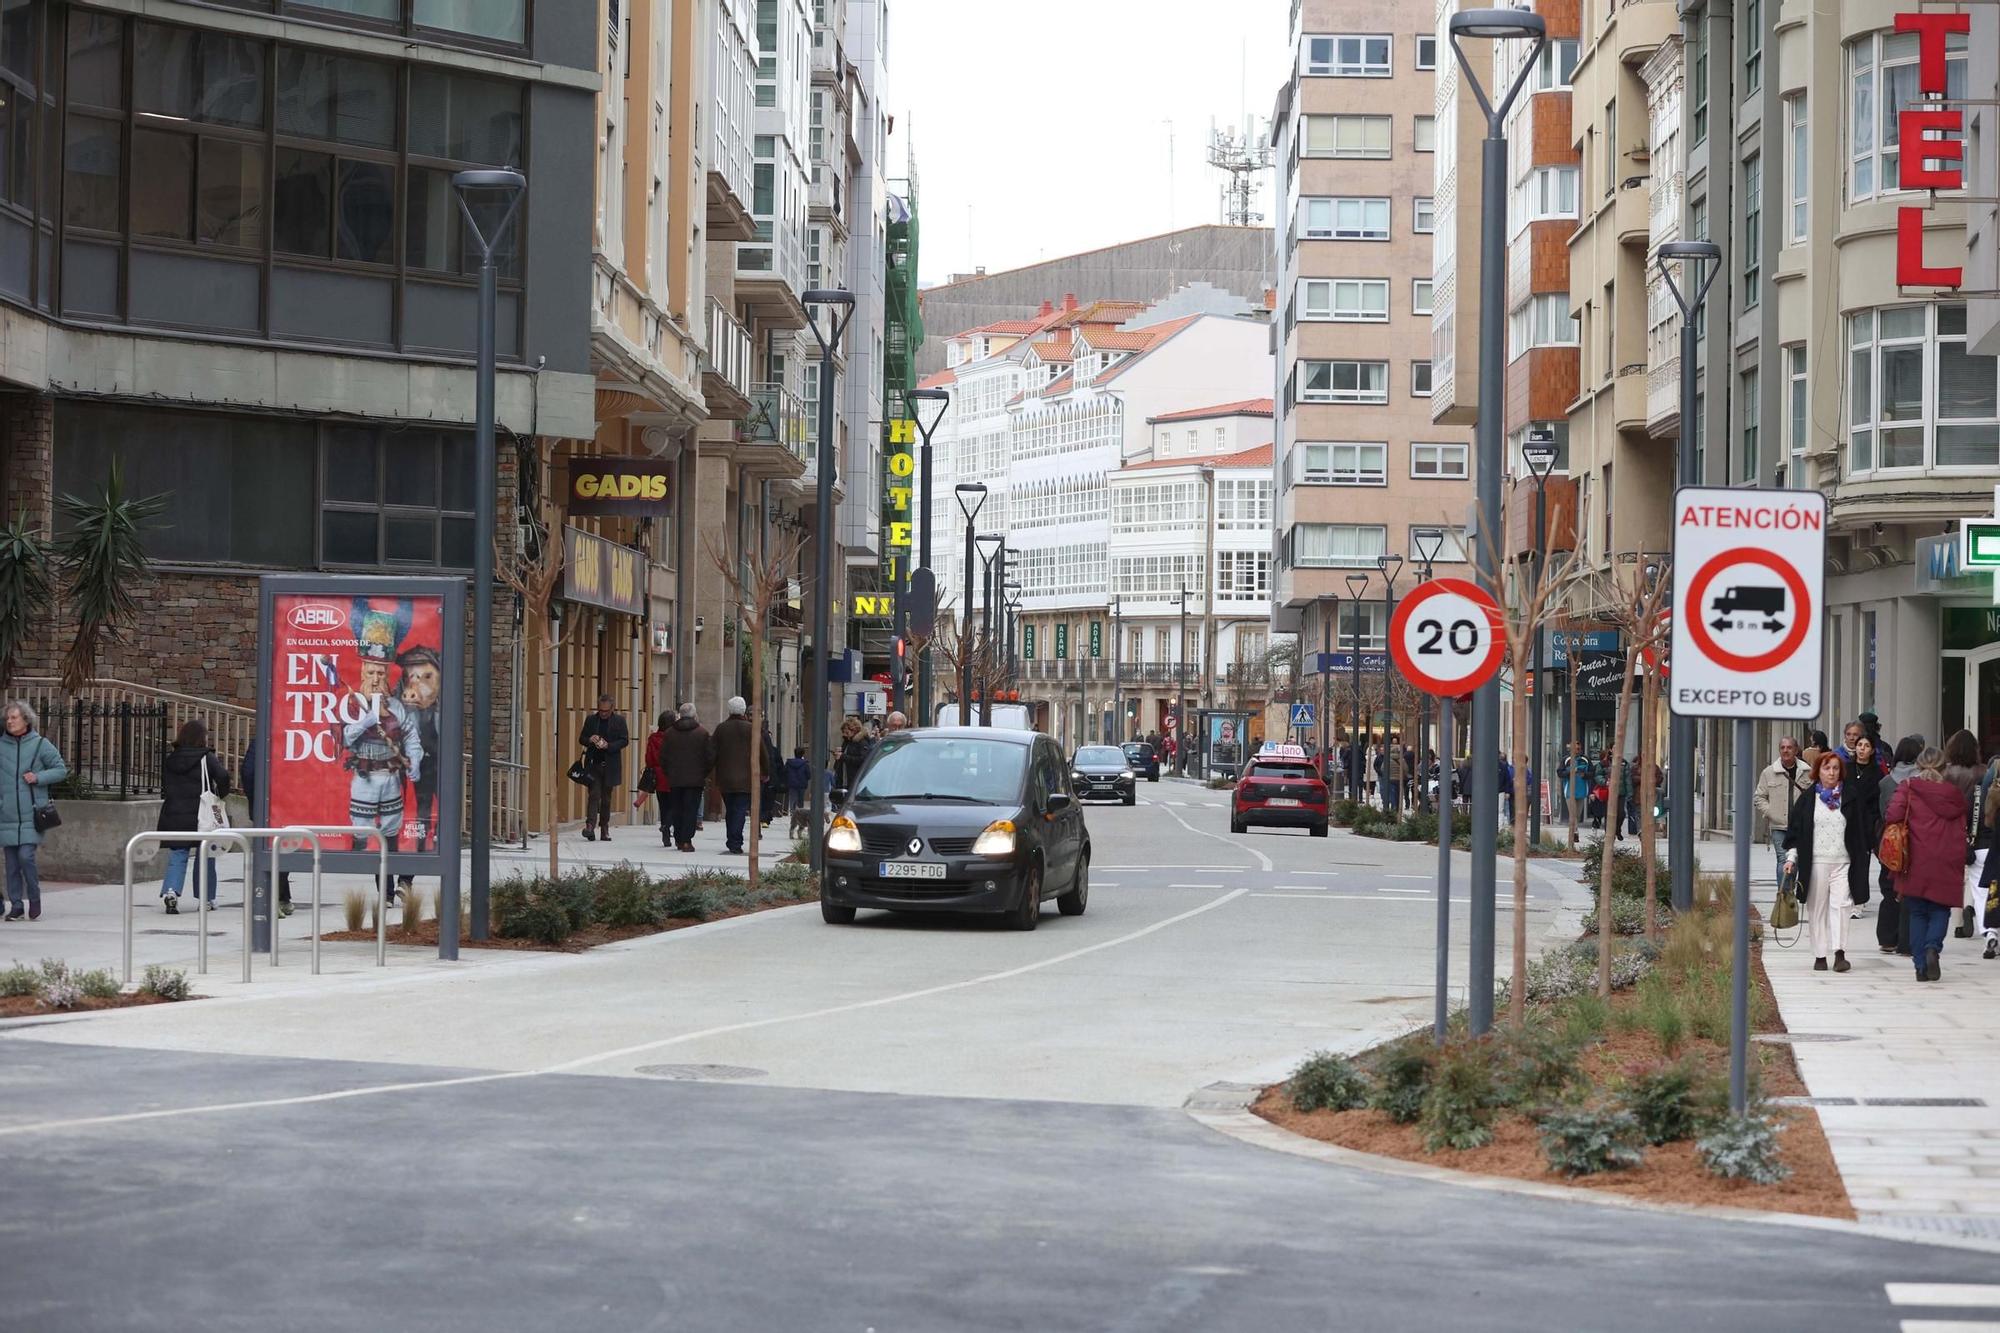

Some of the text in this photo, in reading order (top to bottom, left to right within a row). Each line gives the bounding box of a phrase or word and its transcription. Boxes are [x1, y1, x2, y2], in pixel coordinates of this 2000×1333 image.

[575, 473, 668, 499] GADIS
[1680, 503, 1821, 531] ATENCIÓN
[855, 596, 896, 615] NI
[295, 609, 338, 625] ABRIL
[1737, 620, 1744, 630] 8
[286, 638, 371, 647] EN GALICIA, SOMOS DE
[1417, 619, 1478, 655] 20
[286, 653, 339, 685] EN
[1575, 657, 1607, 676] Frutas
[1588, 671, 1626, 687] Verdura
[1679, 688, 1812, 707] EXCEPTO BUS
[1276, 745, 1301, 755] Llano
[887, 864, 944, 877] 2295 FDG
